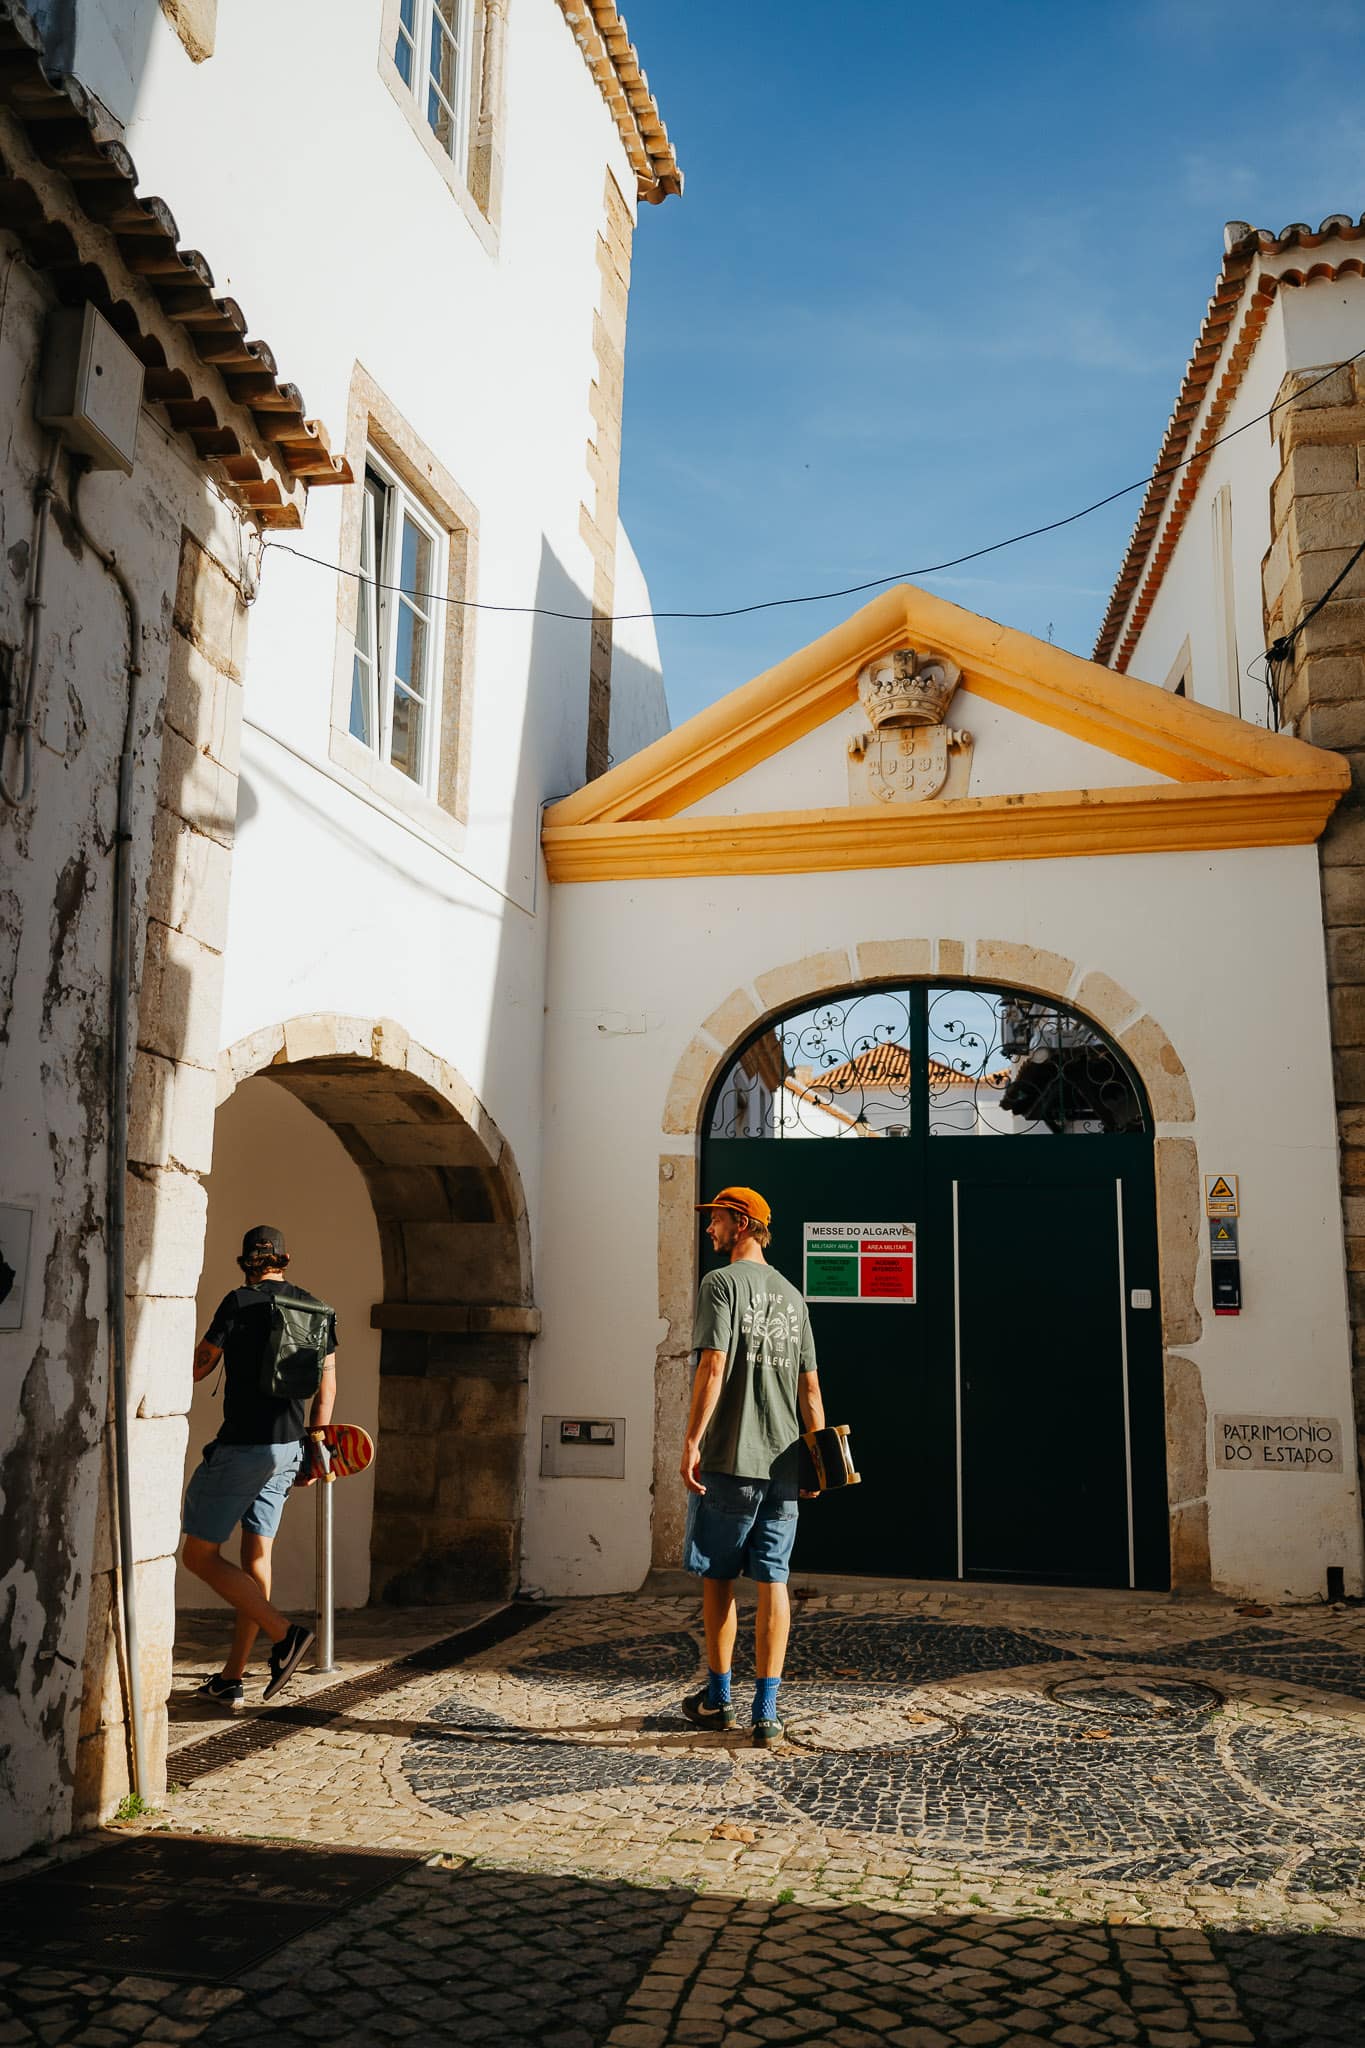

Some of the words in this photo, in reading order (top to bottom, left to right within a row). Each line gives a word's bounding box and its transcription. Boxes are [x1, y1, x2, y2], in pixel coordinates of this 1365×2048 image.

[812, 1227, 844, 1236] MESSE
[847, 1227, 860, 1236] DO
[862, 1227, 909, 1237] ALGARVE
[1224, 1445, 1252, 1461] DO
[1263, 1446, 1334, 1464] ESTADO
